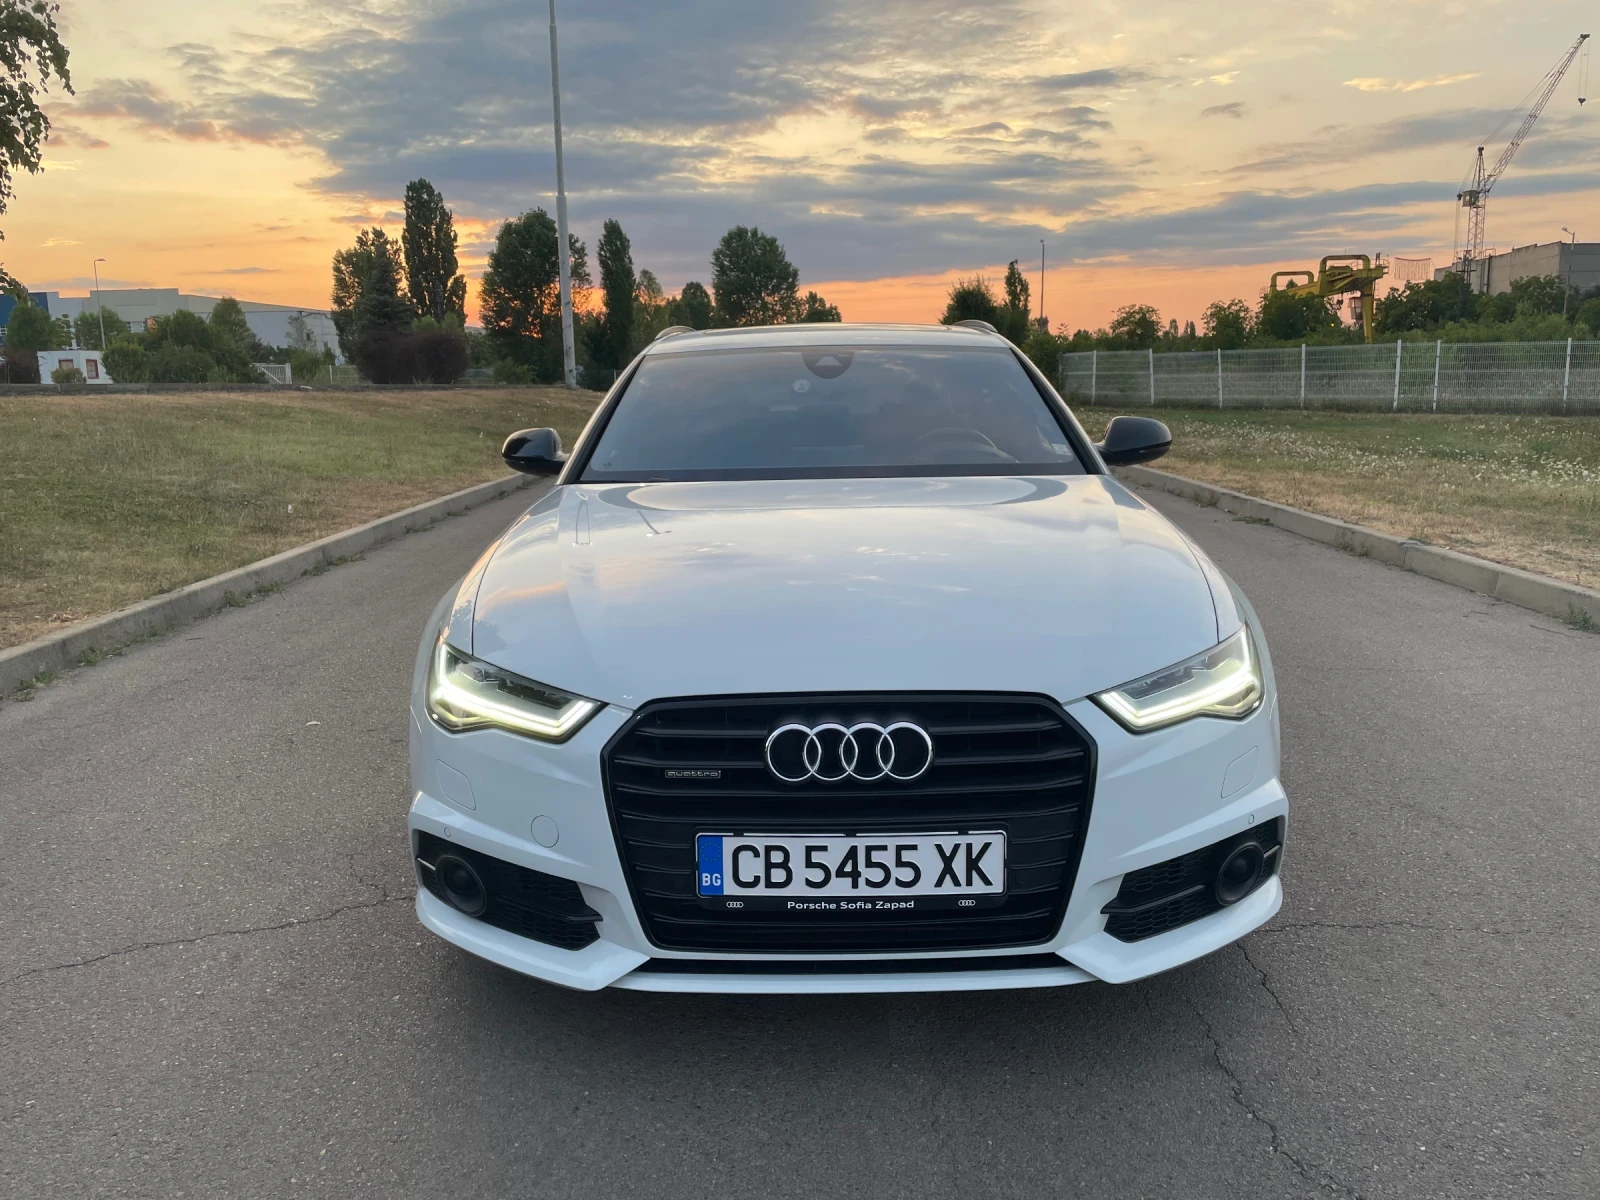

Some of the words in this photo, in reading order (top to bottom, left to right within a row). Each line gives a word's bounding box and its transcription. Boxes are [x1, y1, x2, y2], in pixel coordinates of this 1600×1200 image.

[731, 844, 793, 889] CB
[804, 844, 922, 889] 5455
[933, 841, 994, 888] XK
[702, 873, 721, 887] BG
[787, 901, 837, 910] Porsche
[840, 901, 873, 910] Sofia
[875, 900, 915, 910] Zapad
